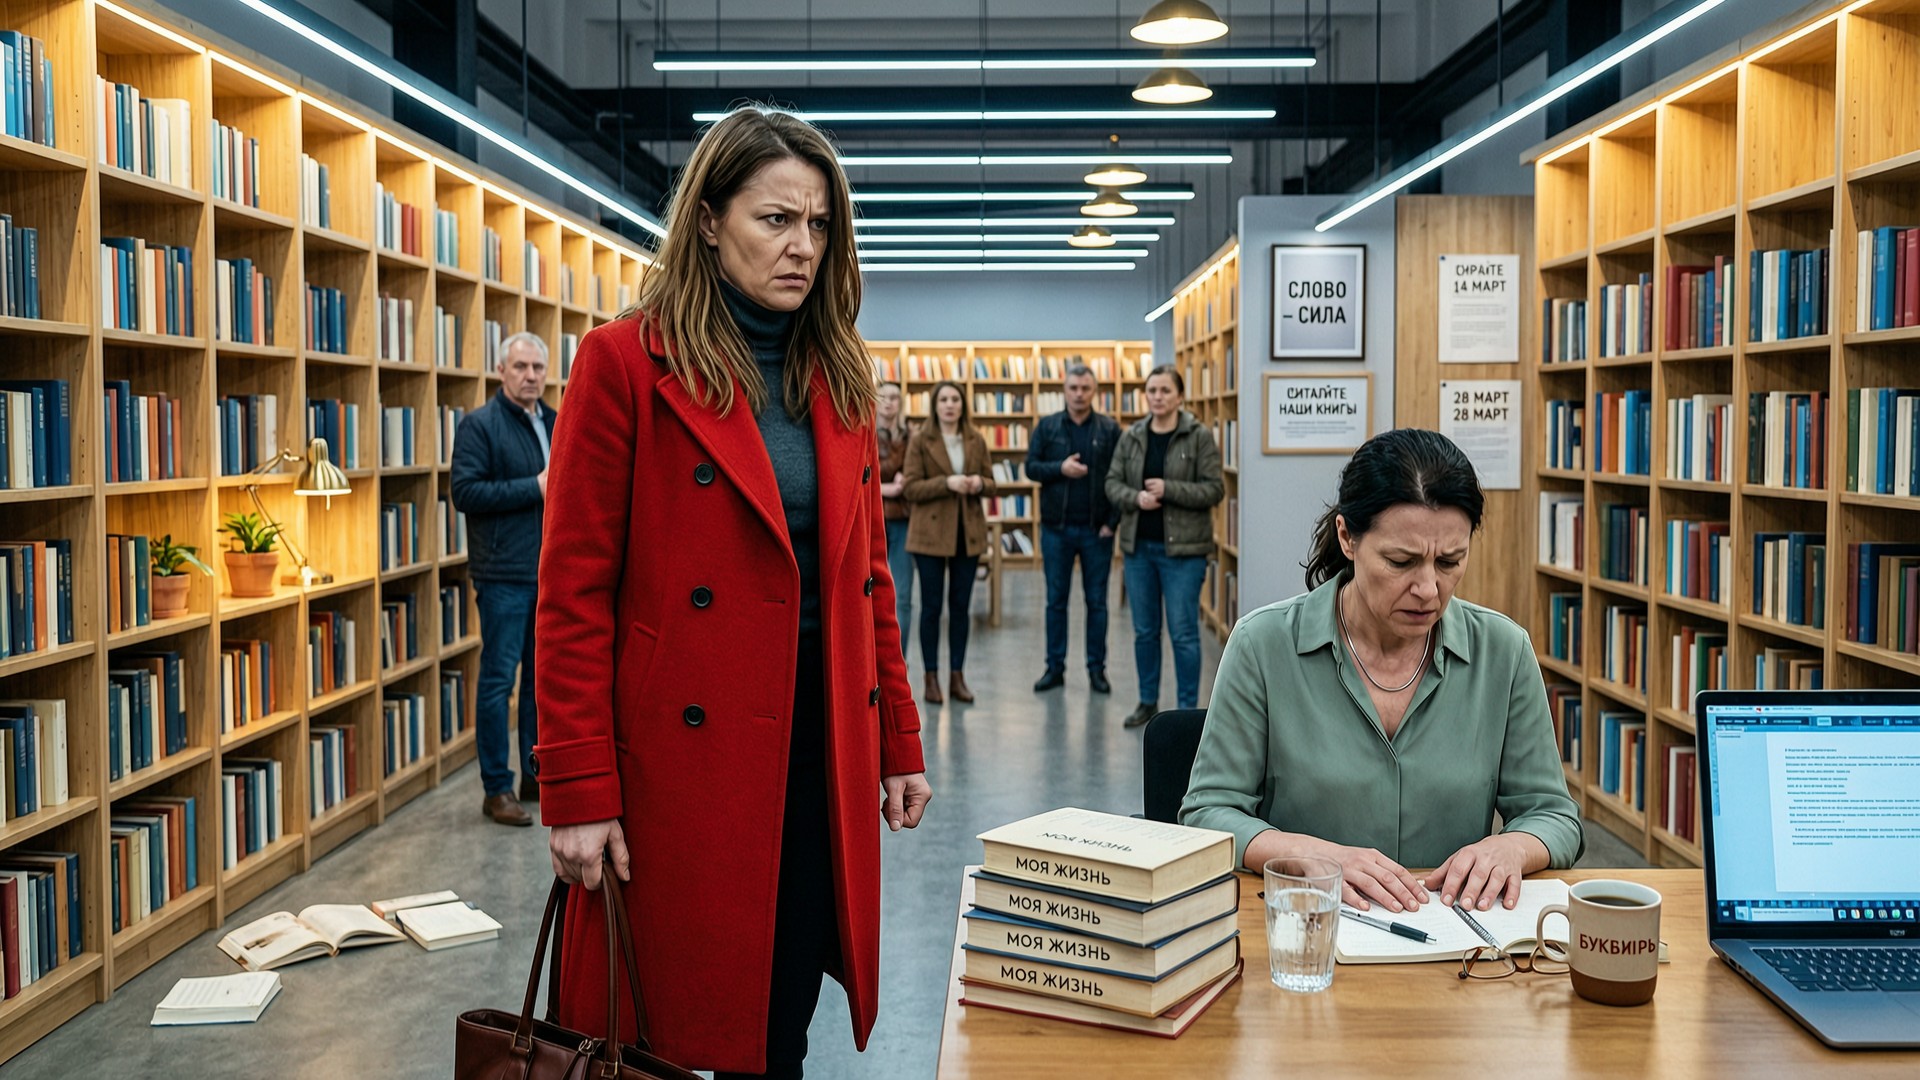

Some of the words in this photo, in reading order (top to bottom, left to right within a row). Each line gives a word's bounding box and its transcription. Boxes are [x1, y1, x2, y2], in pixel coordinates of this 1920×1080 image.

[1288, 281, 1347, 299] СЛОВО
[1454, 280, 1468, 293] 14
[1472, 280, 1506, 293] МАРТ
[1299, 306, 1346, 324] СИЛА
[1454, 392, 1469, 403] 28
[1474, 392, 1509, 403] МАРТ
[1454, 409, 1469, 421] 28
[1474, 409, 1509, 421] МАРТ
[1016, 856, 1049, 875] МОЯ
[1054, 862, 1111, 885] ЖИЗНЬ
[1009, 894, 1041, 914] МОЯ
[1046, 901, 1100, 925] ЖИЗНЬ
[1007, 932, 1043, 951] МОЯ
[1049, 938, 1110, 961] ЖИЗНЬ
[1001, 965, 1037, 984] МОЯ
[1043, 972, 1103, 997] ЖИЗНЬ
